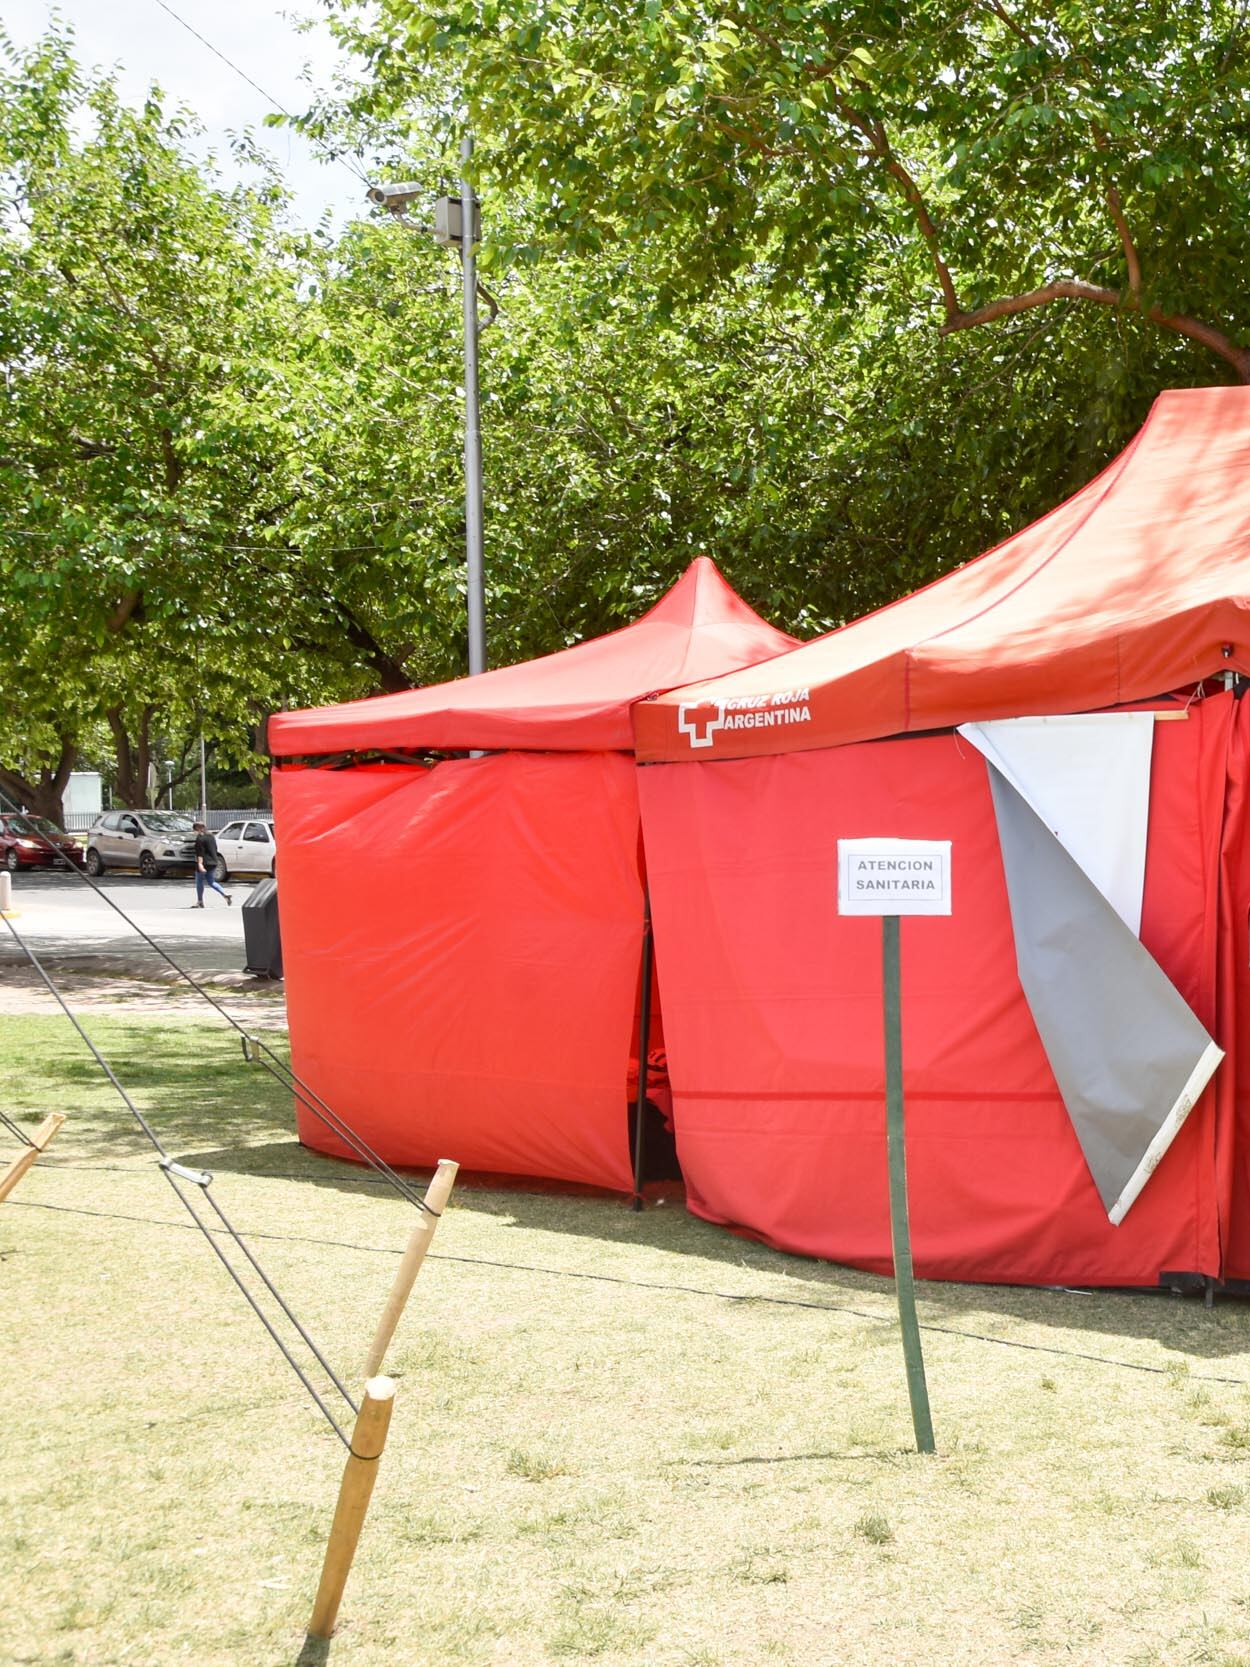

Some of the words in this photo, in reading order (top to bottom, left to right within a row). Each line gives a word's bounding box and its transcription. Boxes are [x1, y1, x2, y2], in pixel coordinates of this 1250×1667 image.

[727, 695, 770, 710] CRUZ
[770, 688, 810, 706] ROJA
[723, 706, 812, 730] ARGENTINA
[857, 860, 933, 871] ATENCION
[856, 879, 936, 890] SANITARIA
